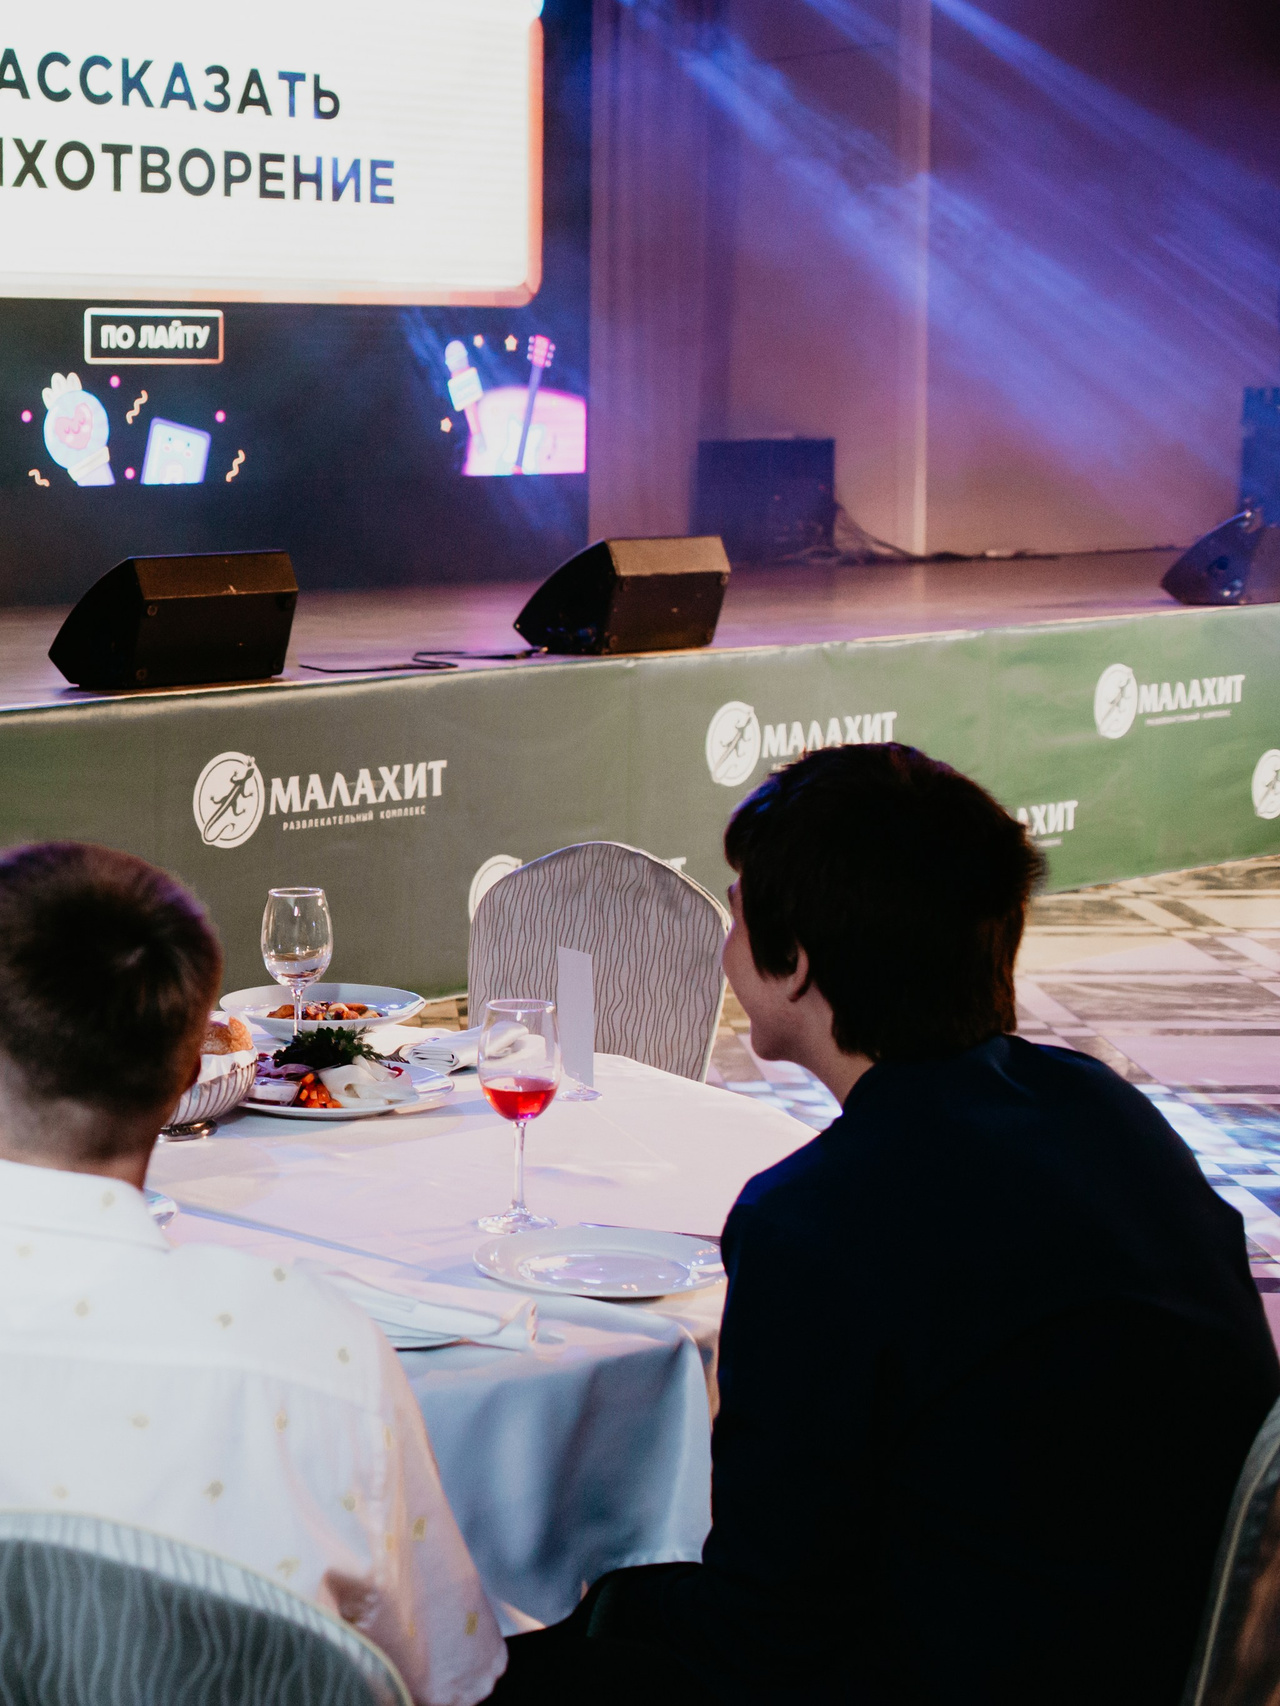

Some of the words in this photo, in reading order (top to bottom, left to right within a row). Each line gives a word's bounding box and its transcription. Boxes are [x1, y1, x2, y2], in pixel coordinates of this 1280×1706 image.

[100, 324, 136, 349] ПО
[138, 319, 210, 349] ЛАЙТУ
[1137, 674, 1246, 714] МАЛАХИТ
[761, 711, 897, 758] МАЛАХИТ
[269, 760, 448, 815] МАЛАХИТ
[282, 810, 374, 831] РАЗВЛЕКАТЕЛЬНЫЙ
[379, 805, 426, 819] КОМПЛЕКС
